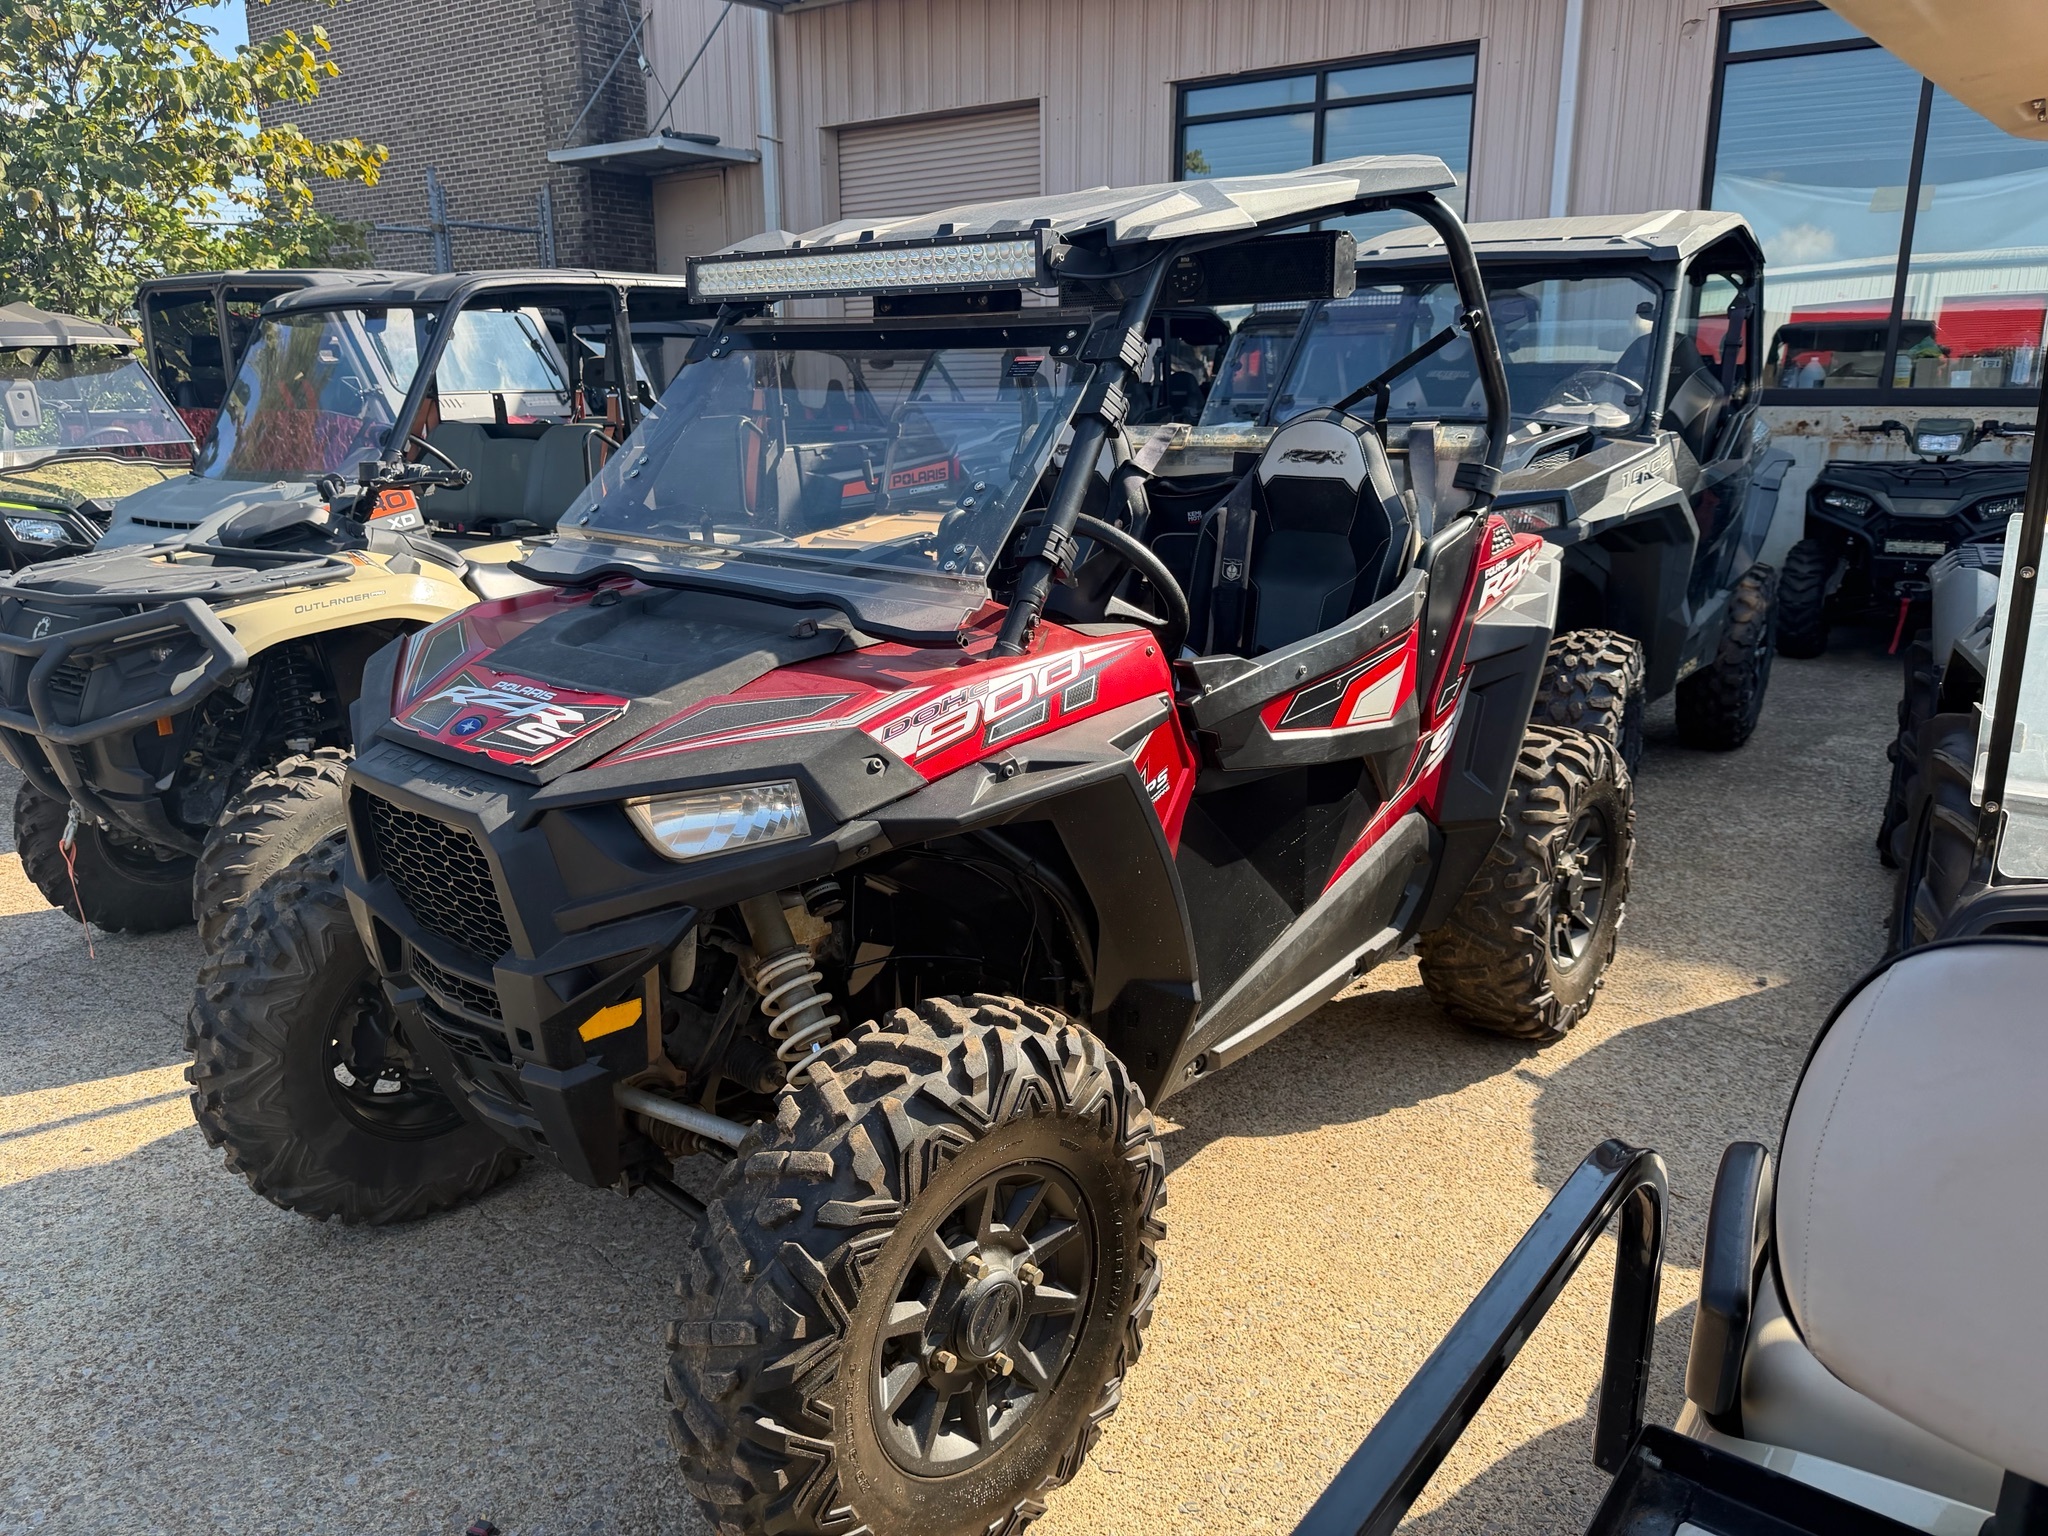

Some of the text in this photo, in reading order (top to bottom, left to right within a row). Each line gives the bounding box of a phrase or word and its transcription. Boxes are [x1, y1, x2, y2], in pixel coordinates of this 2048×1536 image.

[892, 467, 947, 487] POLARIS
[386, 513, 416, 530] XD
[1477, 548, 1532, 611] RZR
[1484, 558, 1508, 580] POLARIS
[294, 592, 371, 615] OUTLANDER
[491, 680, 558, 700] POLARIS
[423, 685, 586, 730] RZR
[880, 678, 991, 743] DOHC
[914, 649, 1087, 760] 900
[497, 722, 578, 746] S
[367, 748, 496, 801] POLARIS
[1145, 767, 1169, 792] PS
